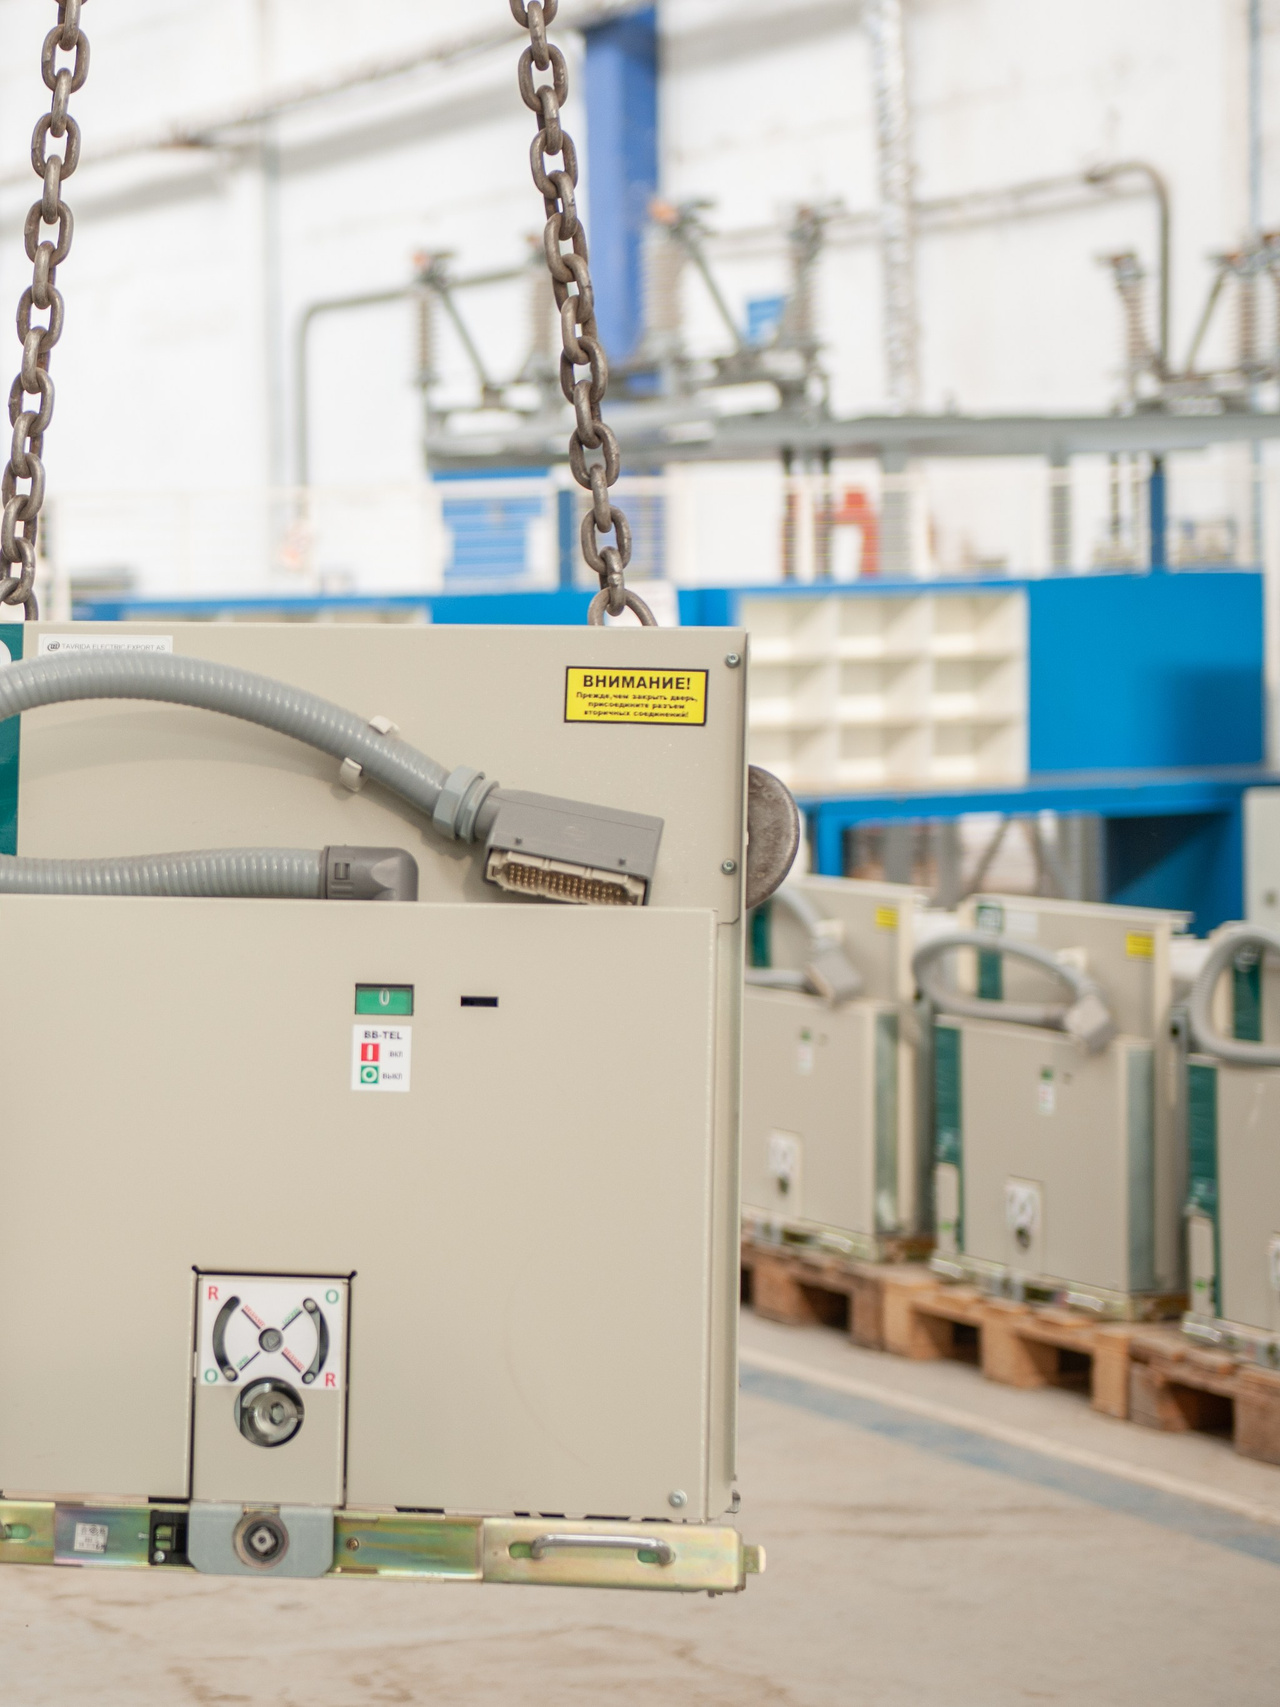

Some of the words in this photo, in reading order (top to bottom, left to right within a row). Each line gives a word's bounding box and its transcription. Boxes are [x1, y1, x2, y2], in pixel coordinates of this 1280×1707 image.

[583, 675, 691, 690] ВНИМАНИЕ!
[588, 701, 649, 709] присоедините
[208, 1286, 219, 1300] R
[325, 1372, 336, 1387] R
